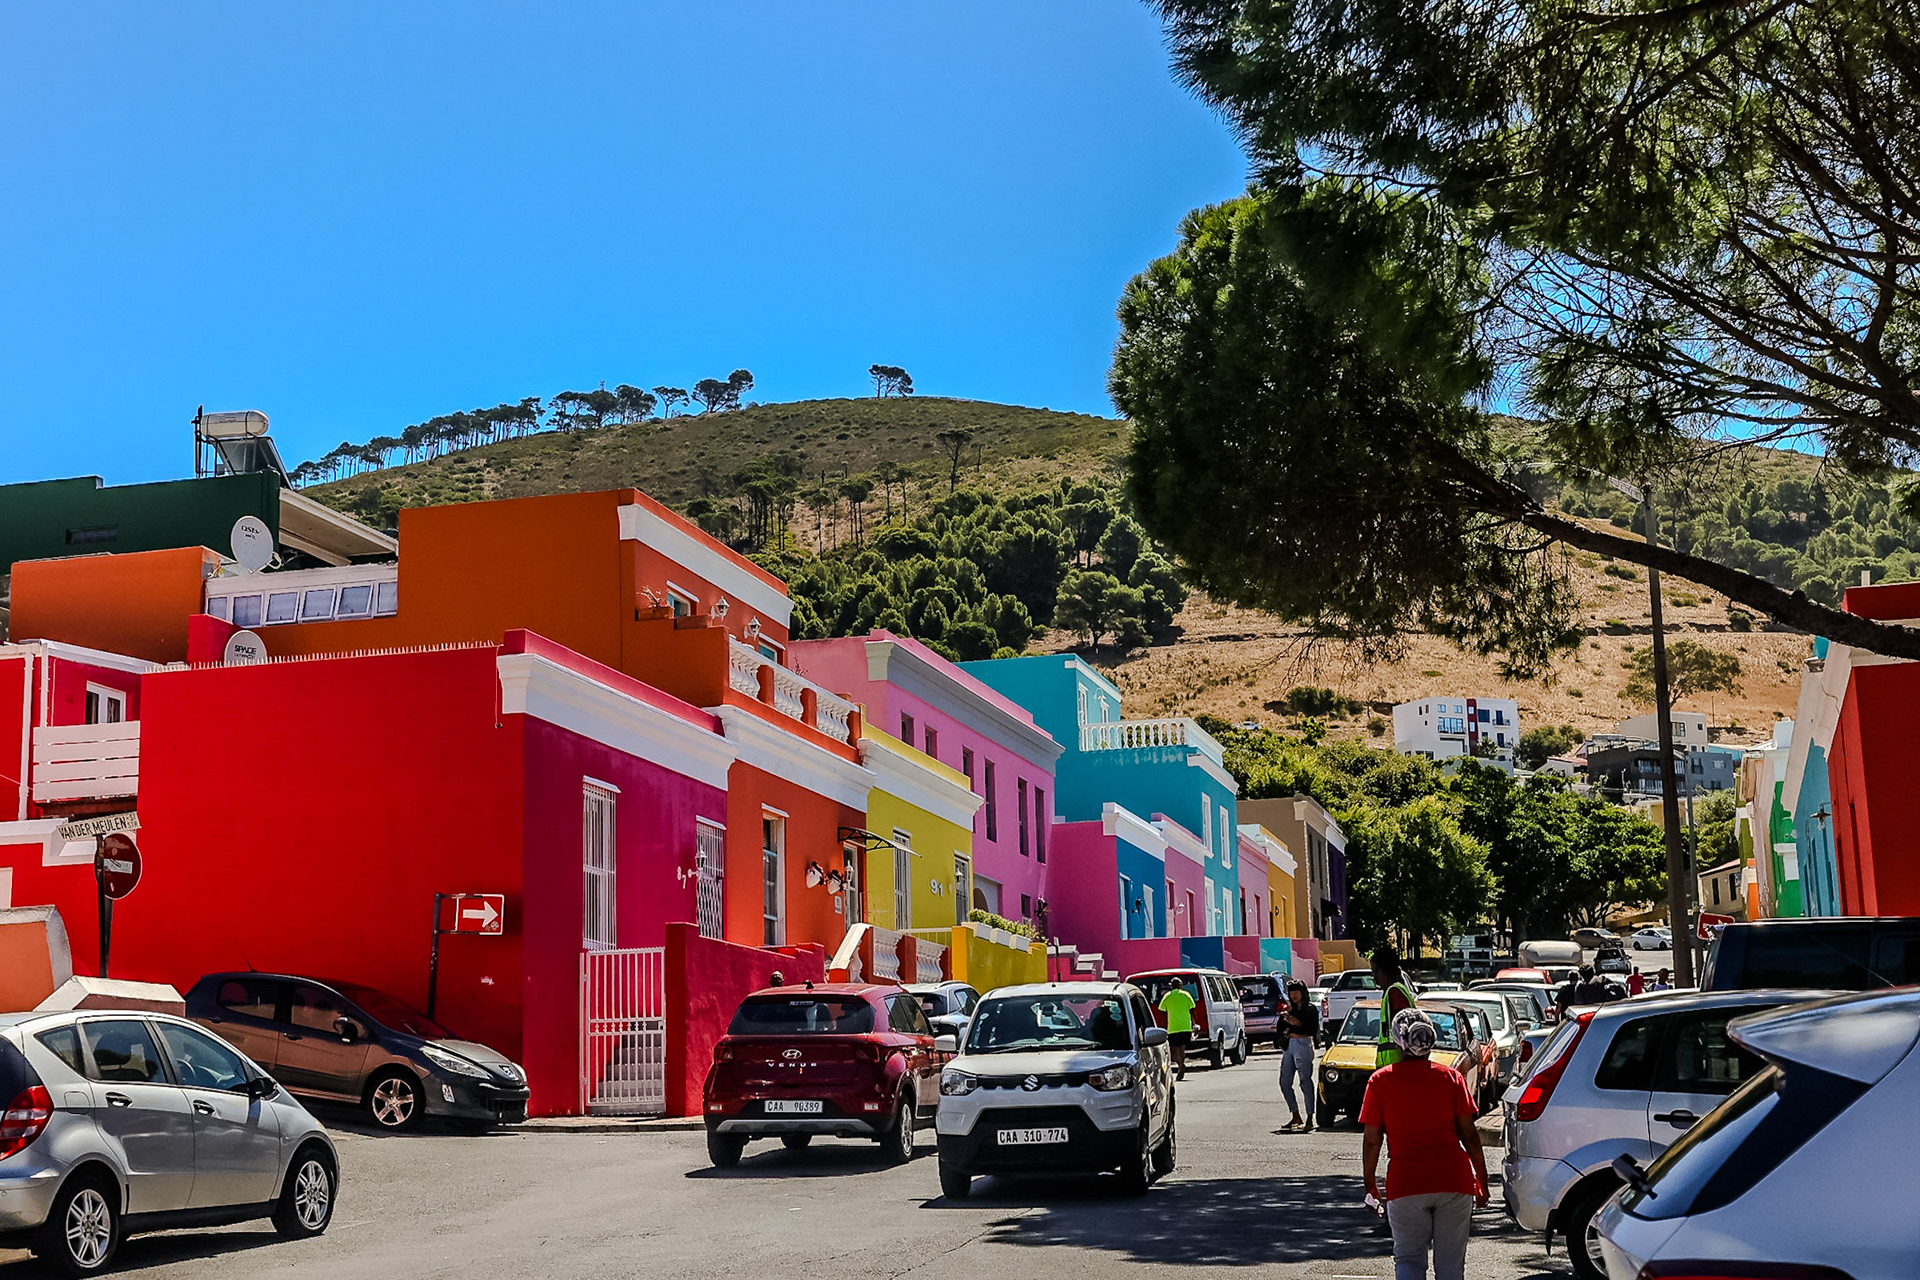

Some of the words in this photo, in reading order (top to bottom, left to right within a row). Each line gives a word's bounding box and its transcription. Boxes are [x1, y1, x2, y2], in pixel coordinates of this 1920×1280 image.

[234, 644, 257, 655] SPACE
[58, 825, 76, 840] VAN
[74, 823, 92, 837] DER
[92, 816, 127, 834] MEULEN
[930, 878, 944, 898] 91
[767, 1101, 784, 1112] CAA
[794, 1101, 820, 1112] 90389
[999, 1130, 1018, 1144] CAA
